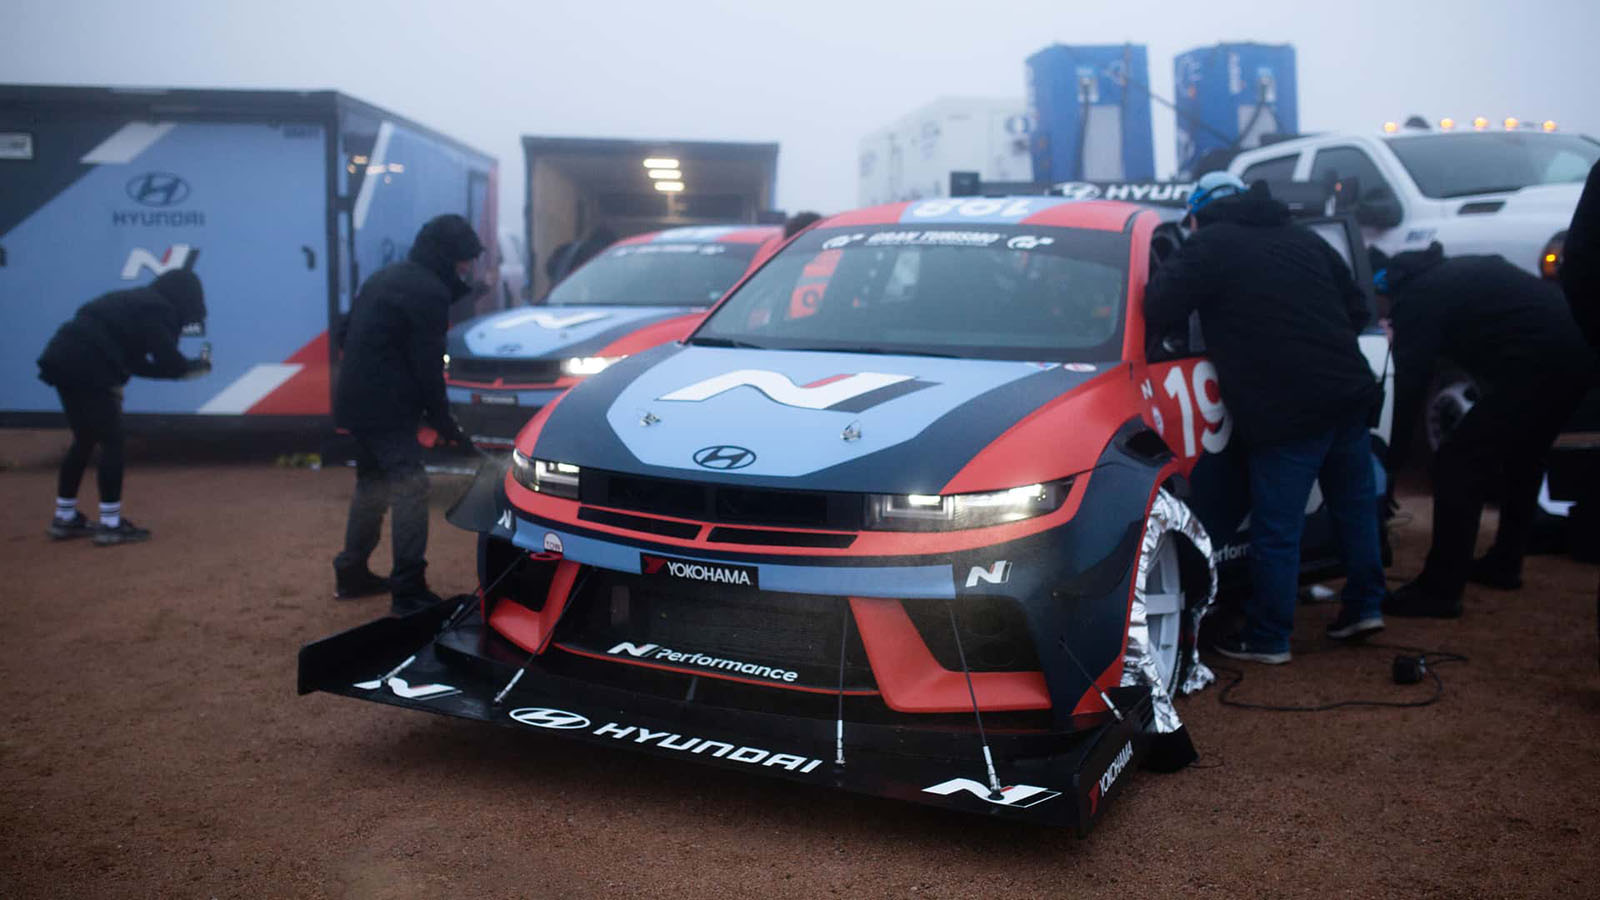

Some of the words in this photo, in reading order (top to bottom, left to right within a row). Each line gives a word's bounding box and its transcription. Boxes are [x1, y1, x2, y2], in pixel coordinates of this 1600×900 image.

[112, 210, 206, 227] HYUNDAI
[667, 561, 751, 585] YOKOHAMA
[655, 649, 798, 682] Performance
[593, 722, 824, 774] HYUNDAI
[1099, 739, 1134, 798] YOKOHAMA
